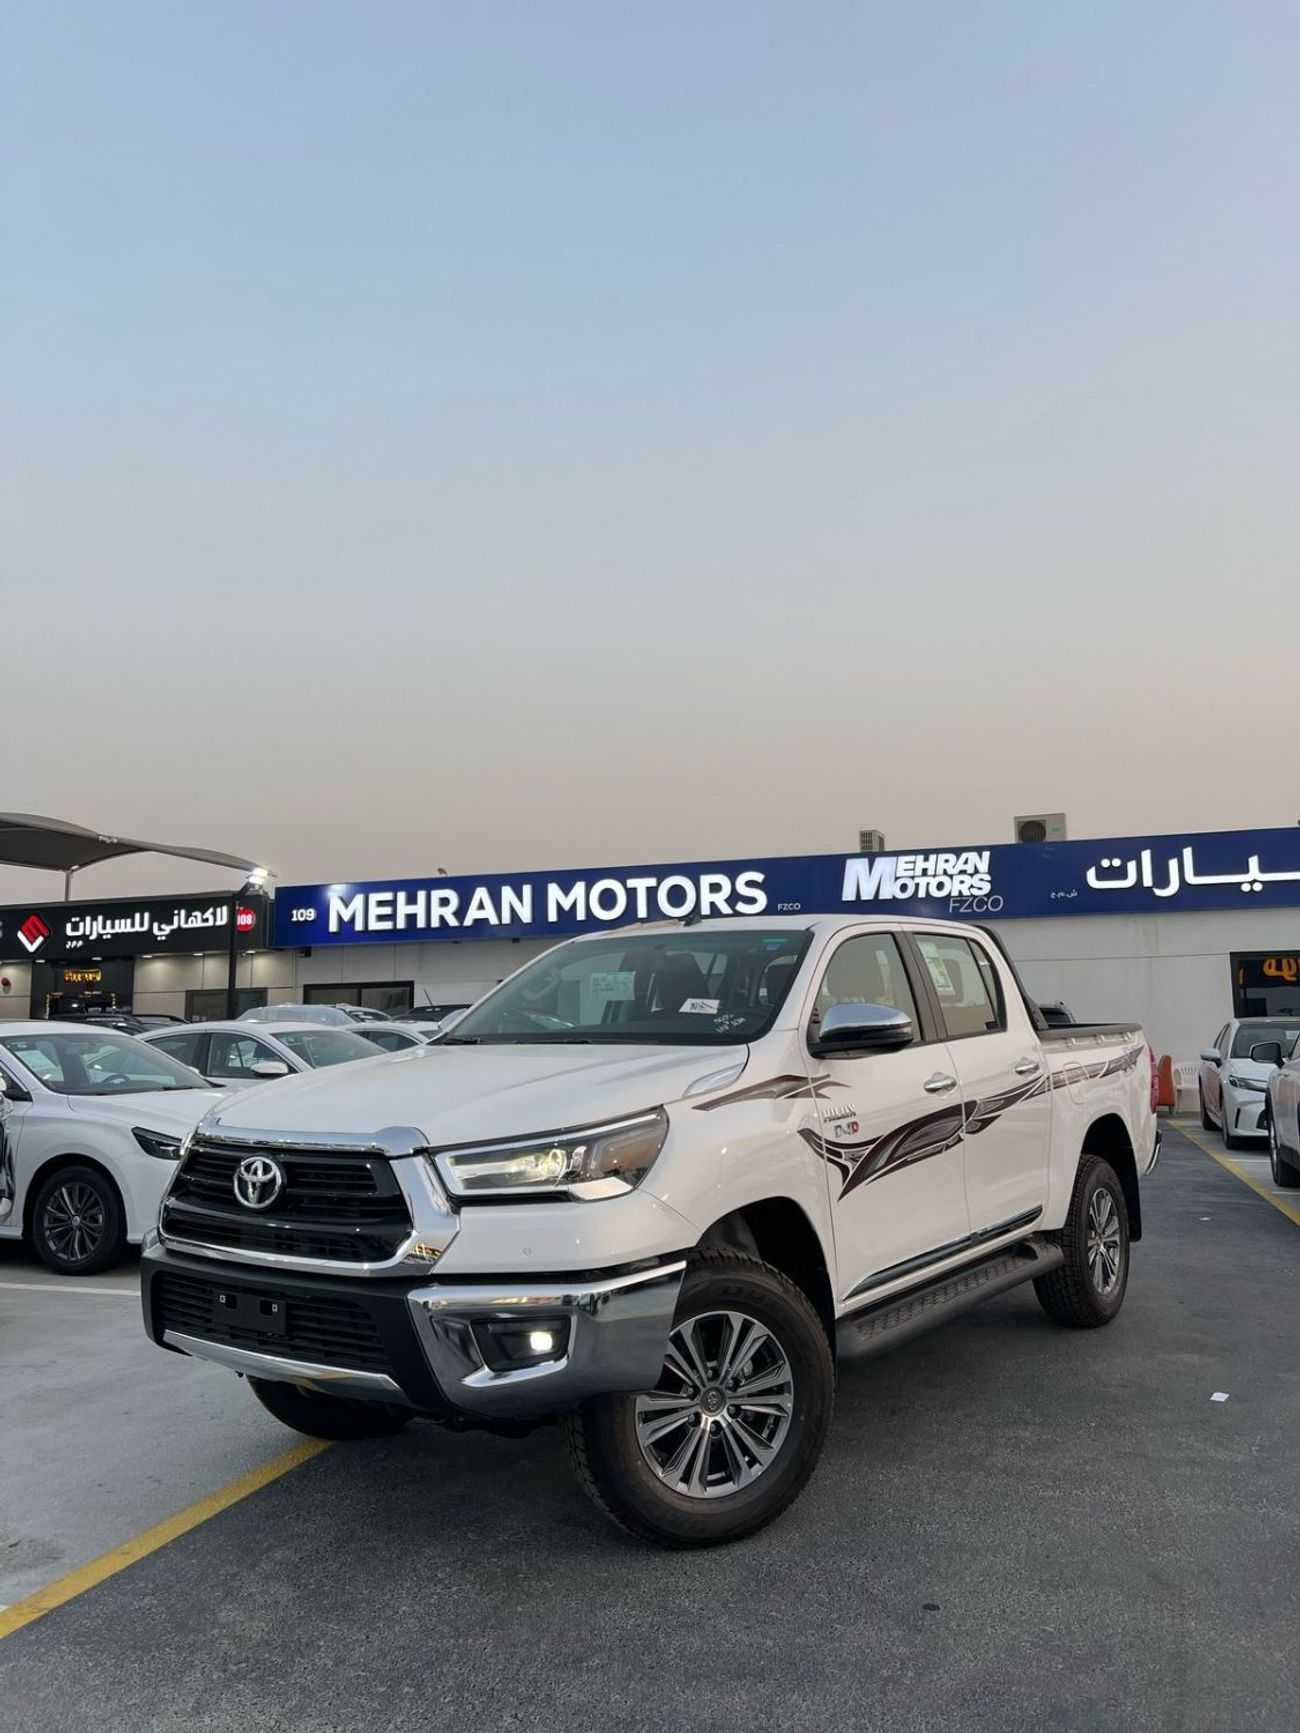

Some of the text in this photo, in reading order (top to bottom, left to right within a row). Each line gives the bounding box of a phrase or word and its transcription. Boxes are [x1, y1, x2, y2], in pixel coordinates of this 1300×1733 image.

[328, 871, 768, 933] MEHRAN MOTORS
[777, 902, 801, 912] FZCO
[949, 895, 1004, 913] FZCO
[236, 914, 253, 926] 108
[291, 908, 317, 921] 109
[65, 911, 150, 940] للسيارات
